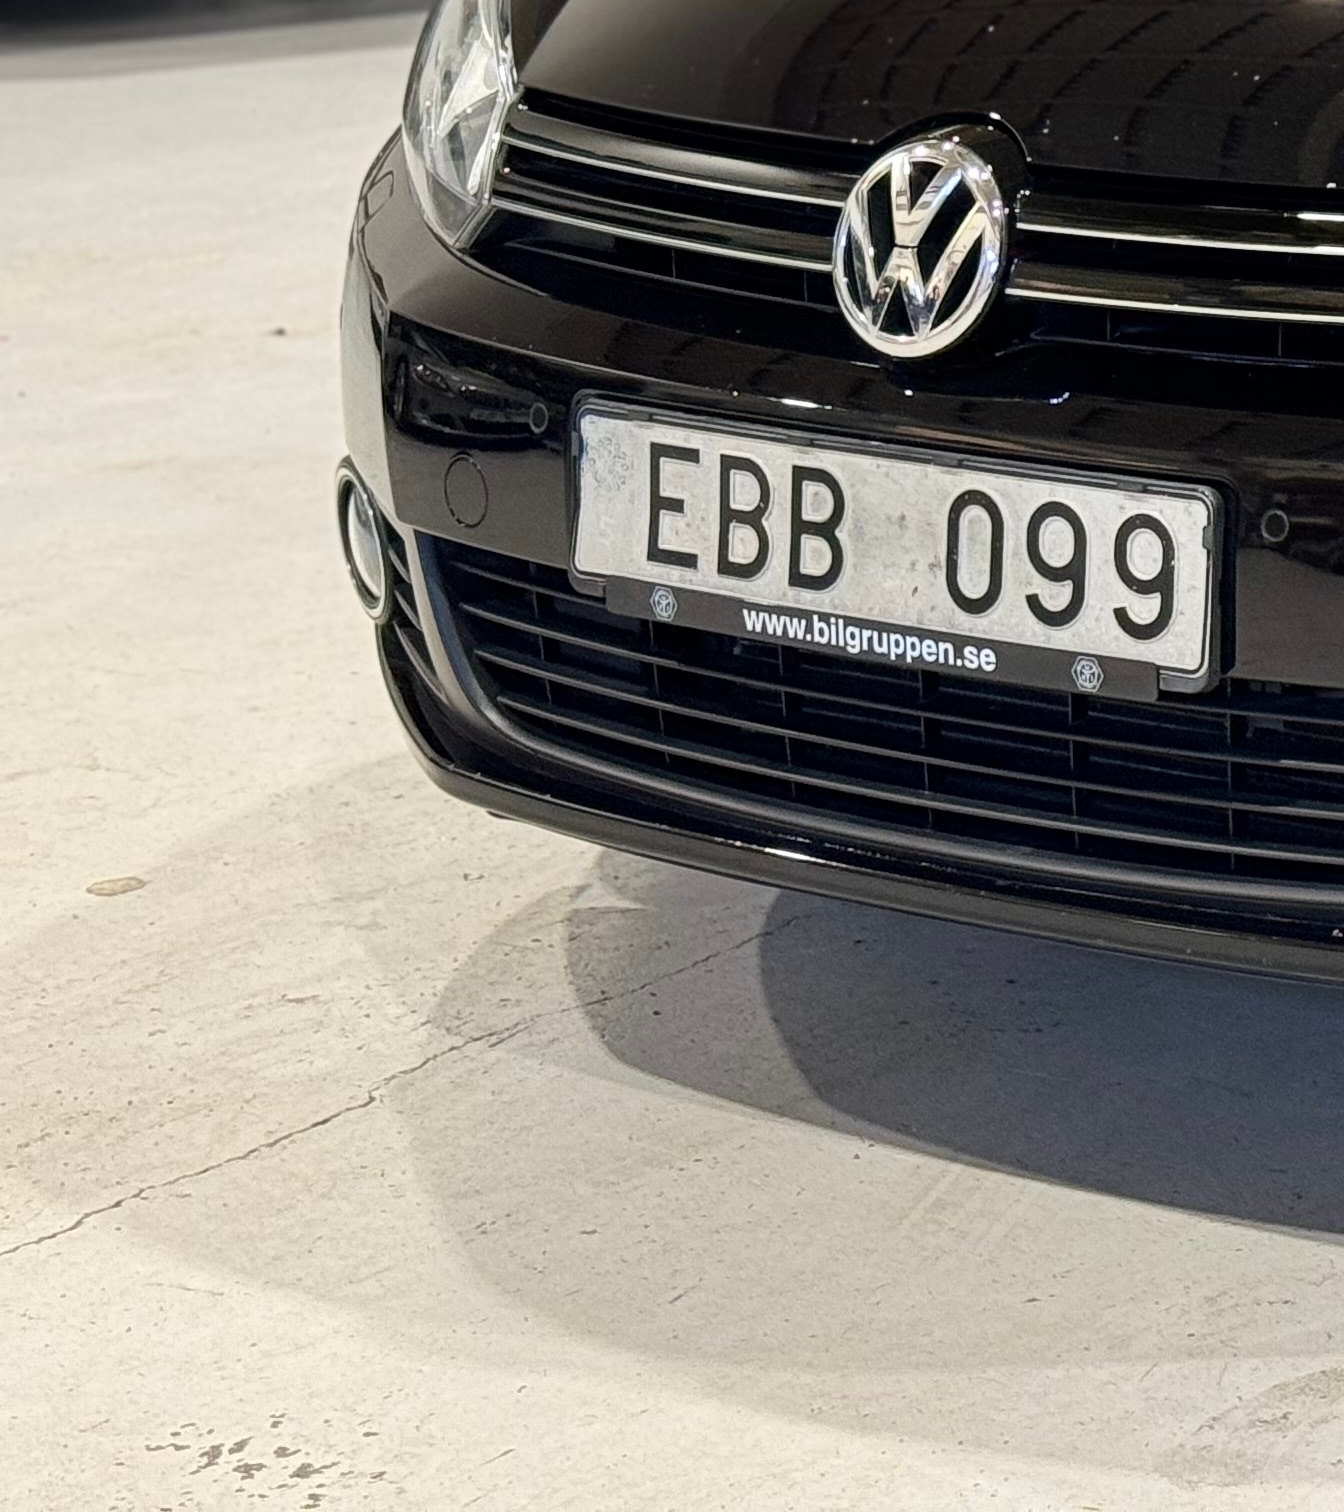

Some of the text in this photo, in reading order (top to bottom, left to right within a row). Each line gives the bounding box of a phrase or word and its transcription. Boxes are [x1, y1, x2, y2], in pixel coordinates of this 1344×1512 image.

[646, 441, 1176, 641] EBB 099
[743, 607, 998, 673] www.bilgruppen.se
